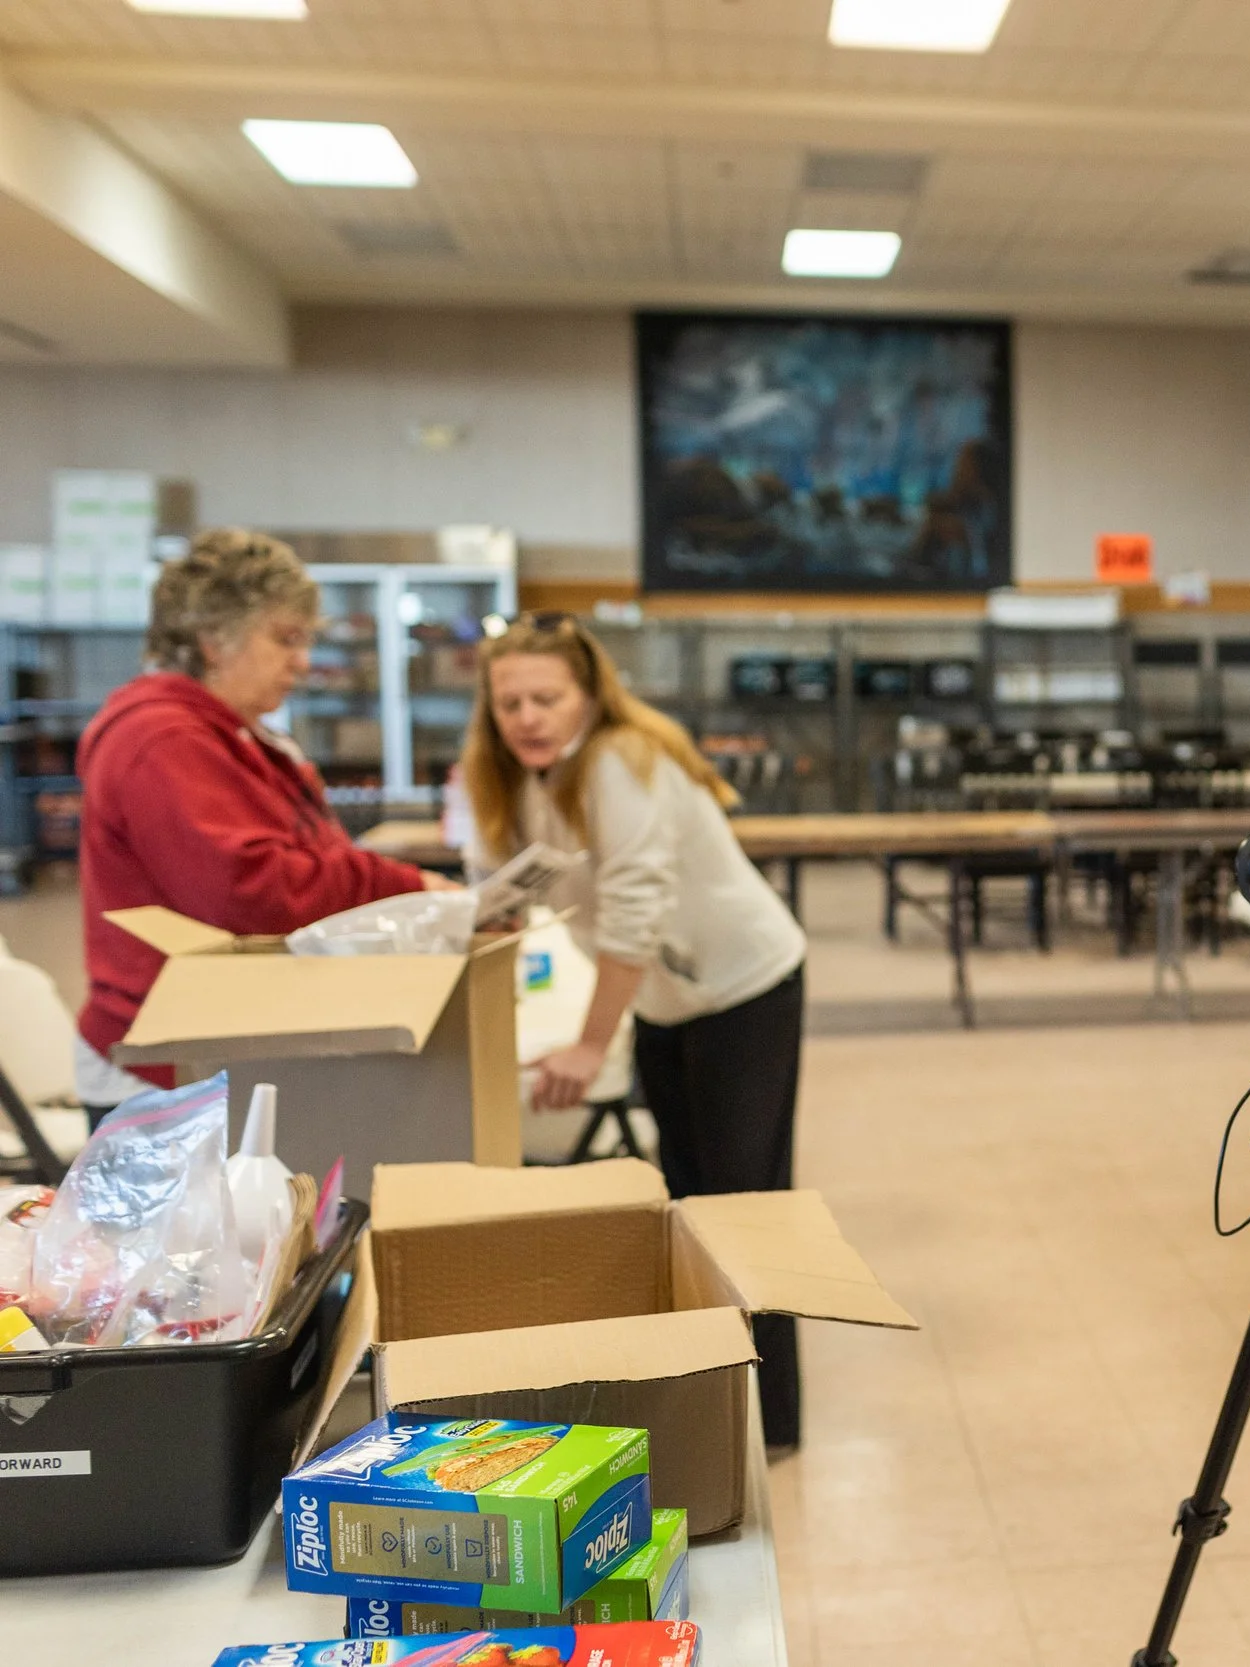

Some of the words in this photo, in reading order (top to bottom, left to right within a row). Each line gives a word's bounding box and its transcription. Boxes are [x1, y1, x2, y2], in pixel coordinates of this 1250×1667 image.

[608, 1435, 648, 1476] SANDWICH
[337, 1510, 345, 1531] made
[562, 1491, 578, 1513] 145
[296, 1496, 326, 1569] Ziploc
[338, 1532, 346, 1565] Mindfully
[513, 1519, 525, 1584] SANDWICH
[585, 1513, 629, 1569] Ziploc
[364, 1600, 390, 1639] loc
